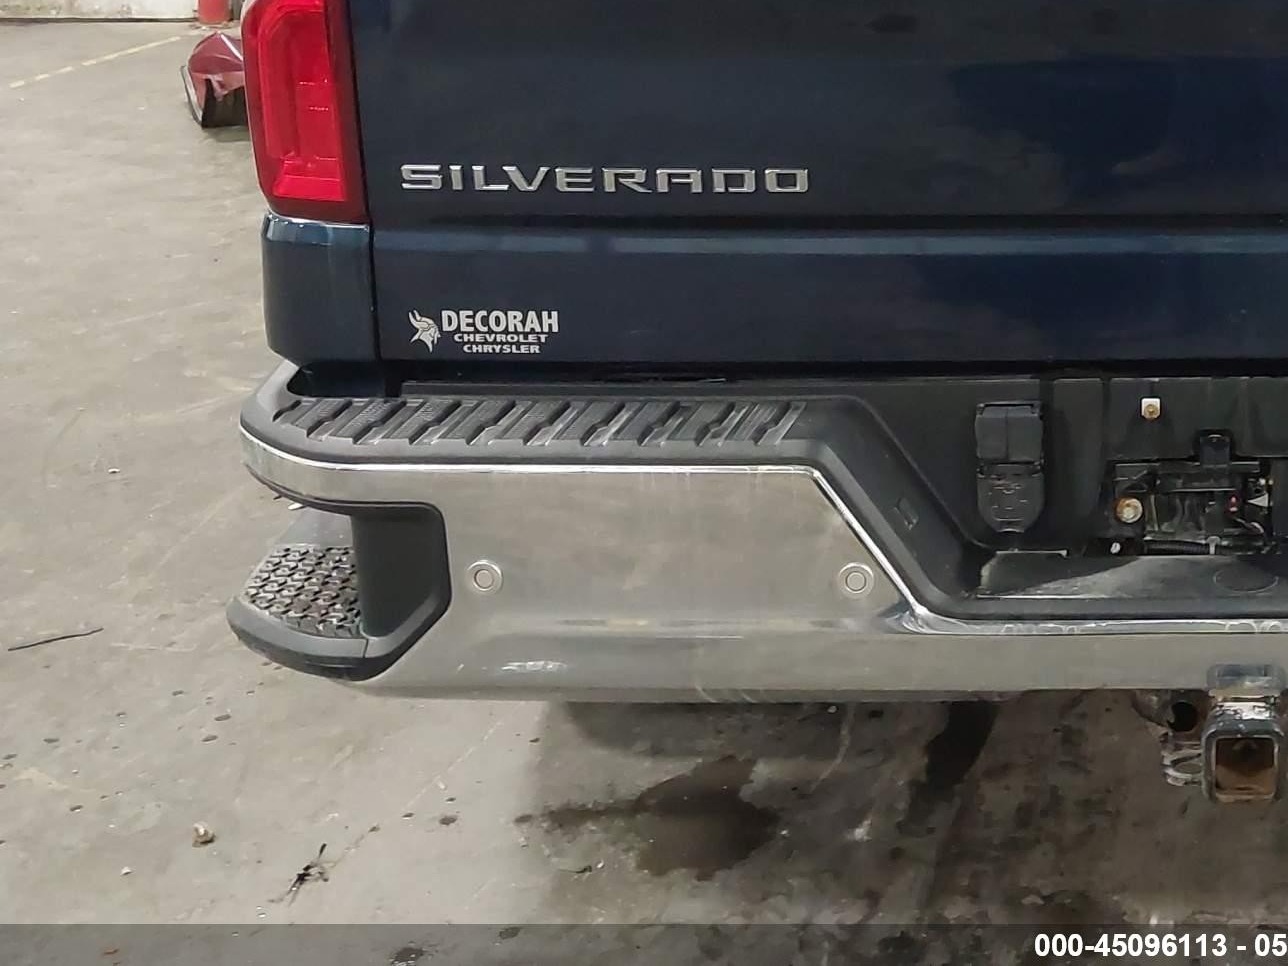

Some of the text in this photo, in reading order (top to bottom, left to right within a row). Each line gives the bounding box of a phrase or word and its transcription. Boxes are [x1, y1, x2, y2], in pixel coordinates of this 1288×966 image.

[400, 164, 809, 193] SILVERADO
[441, 310, 559, 332] DECORAH
[454, 333, 548, 343] CHEVROLET
[463, 344, 540, 354] CHRYSLER
